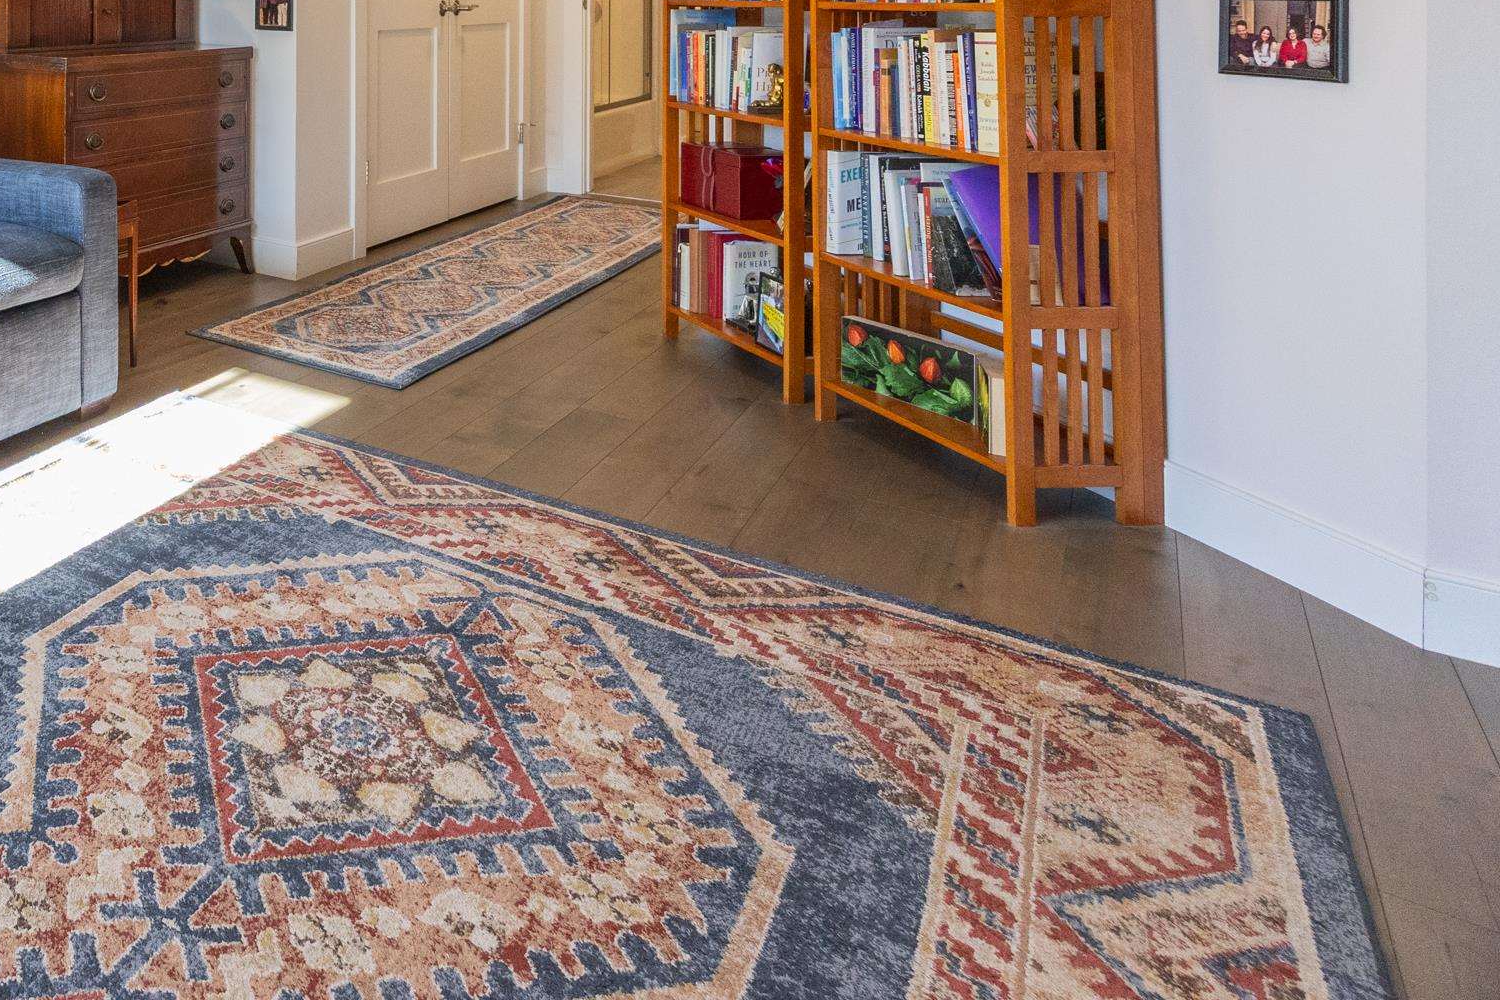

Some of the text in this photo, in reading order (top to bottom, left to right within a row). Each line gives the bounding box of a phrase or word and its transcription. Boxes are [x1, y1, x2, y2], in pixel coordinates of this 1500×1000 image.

[922, 50, 930, 92] Kabbalah
[738, 251, 756, 259] HOUR
[735, 260, 772, 269] THE HEART
